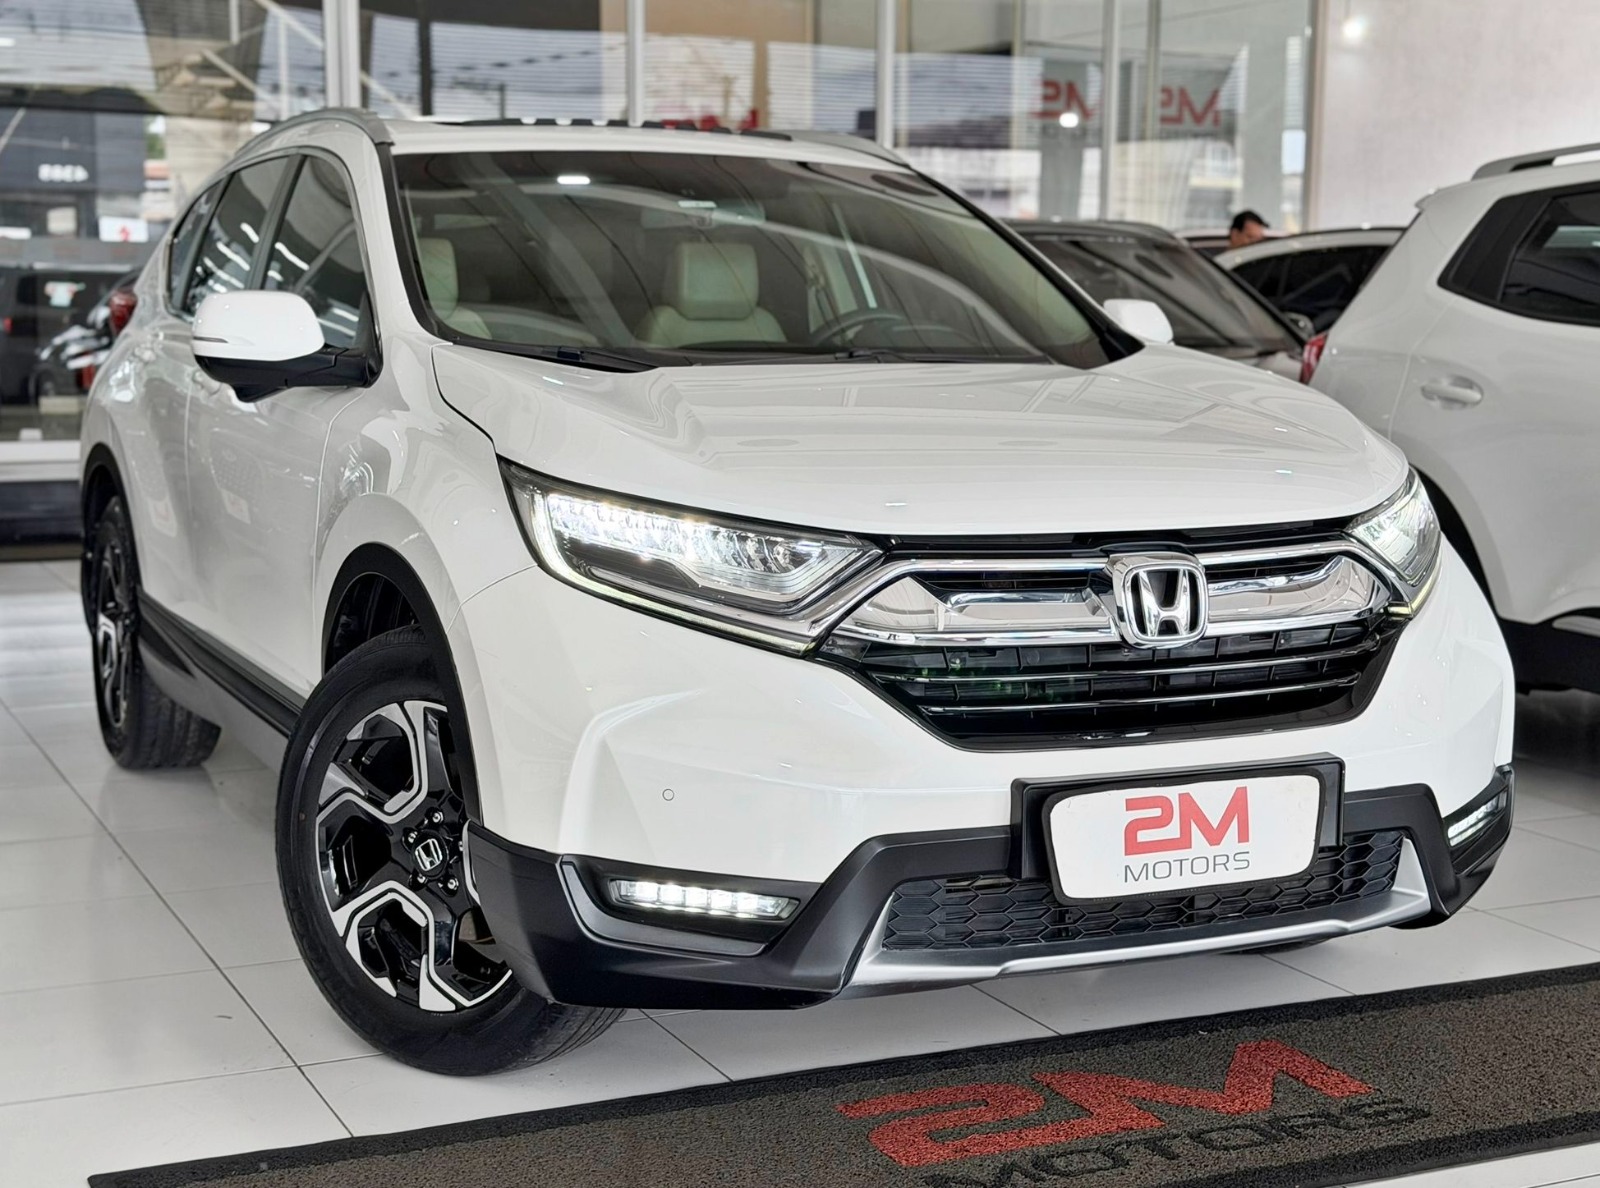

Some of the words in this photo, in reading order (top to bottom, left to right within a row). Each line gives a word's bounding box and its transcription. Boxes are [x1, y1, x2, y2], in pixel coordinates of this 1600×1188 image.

[1124, 786, 1250, 856] 2M
[1124, 851, 1250, 883] MOTORS
[836, 1039, 1377, 1167] 2M
